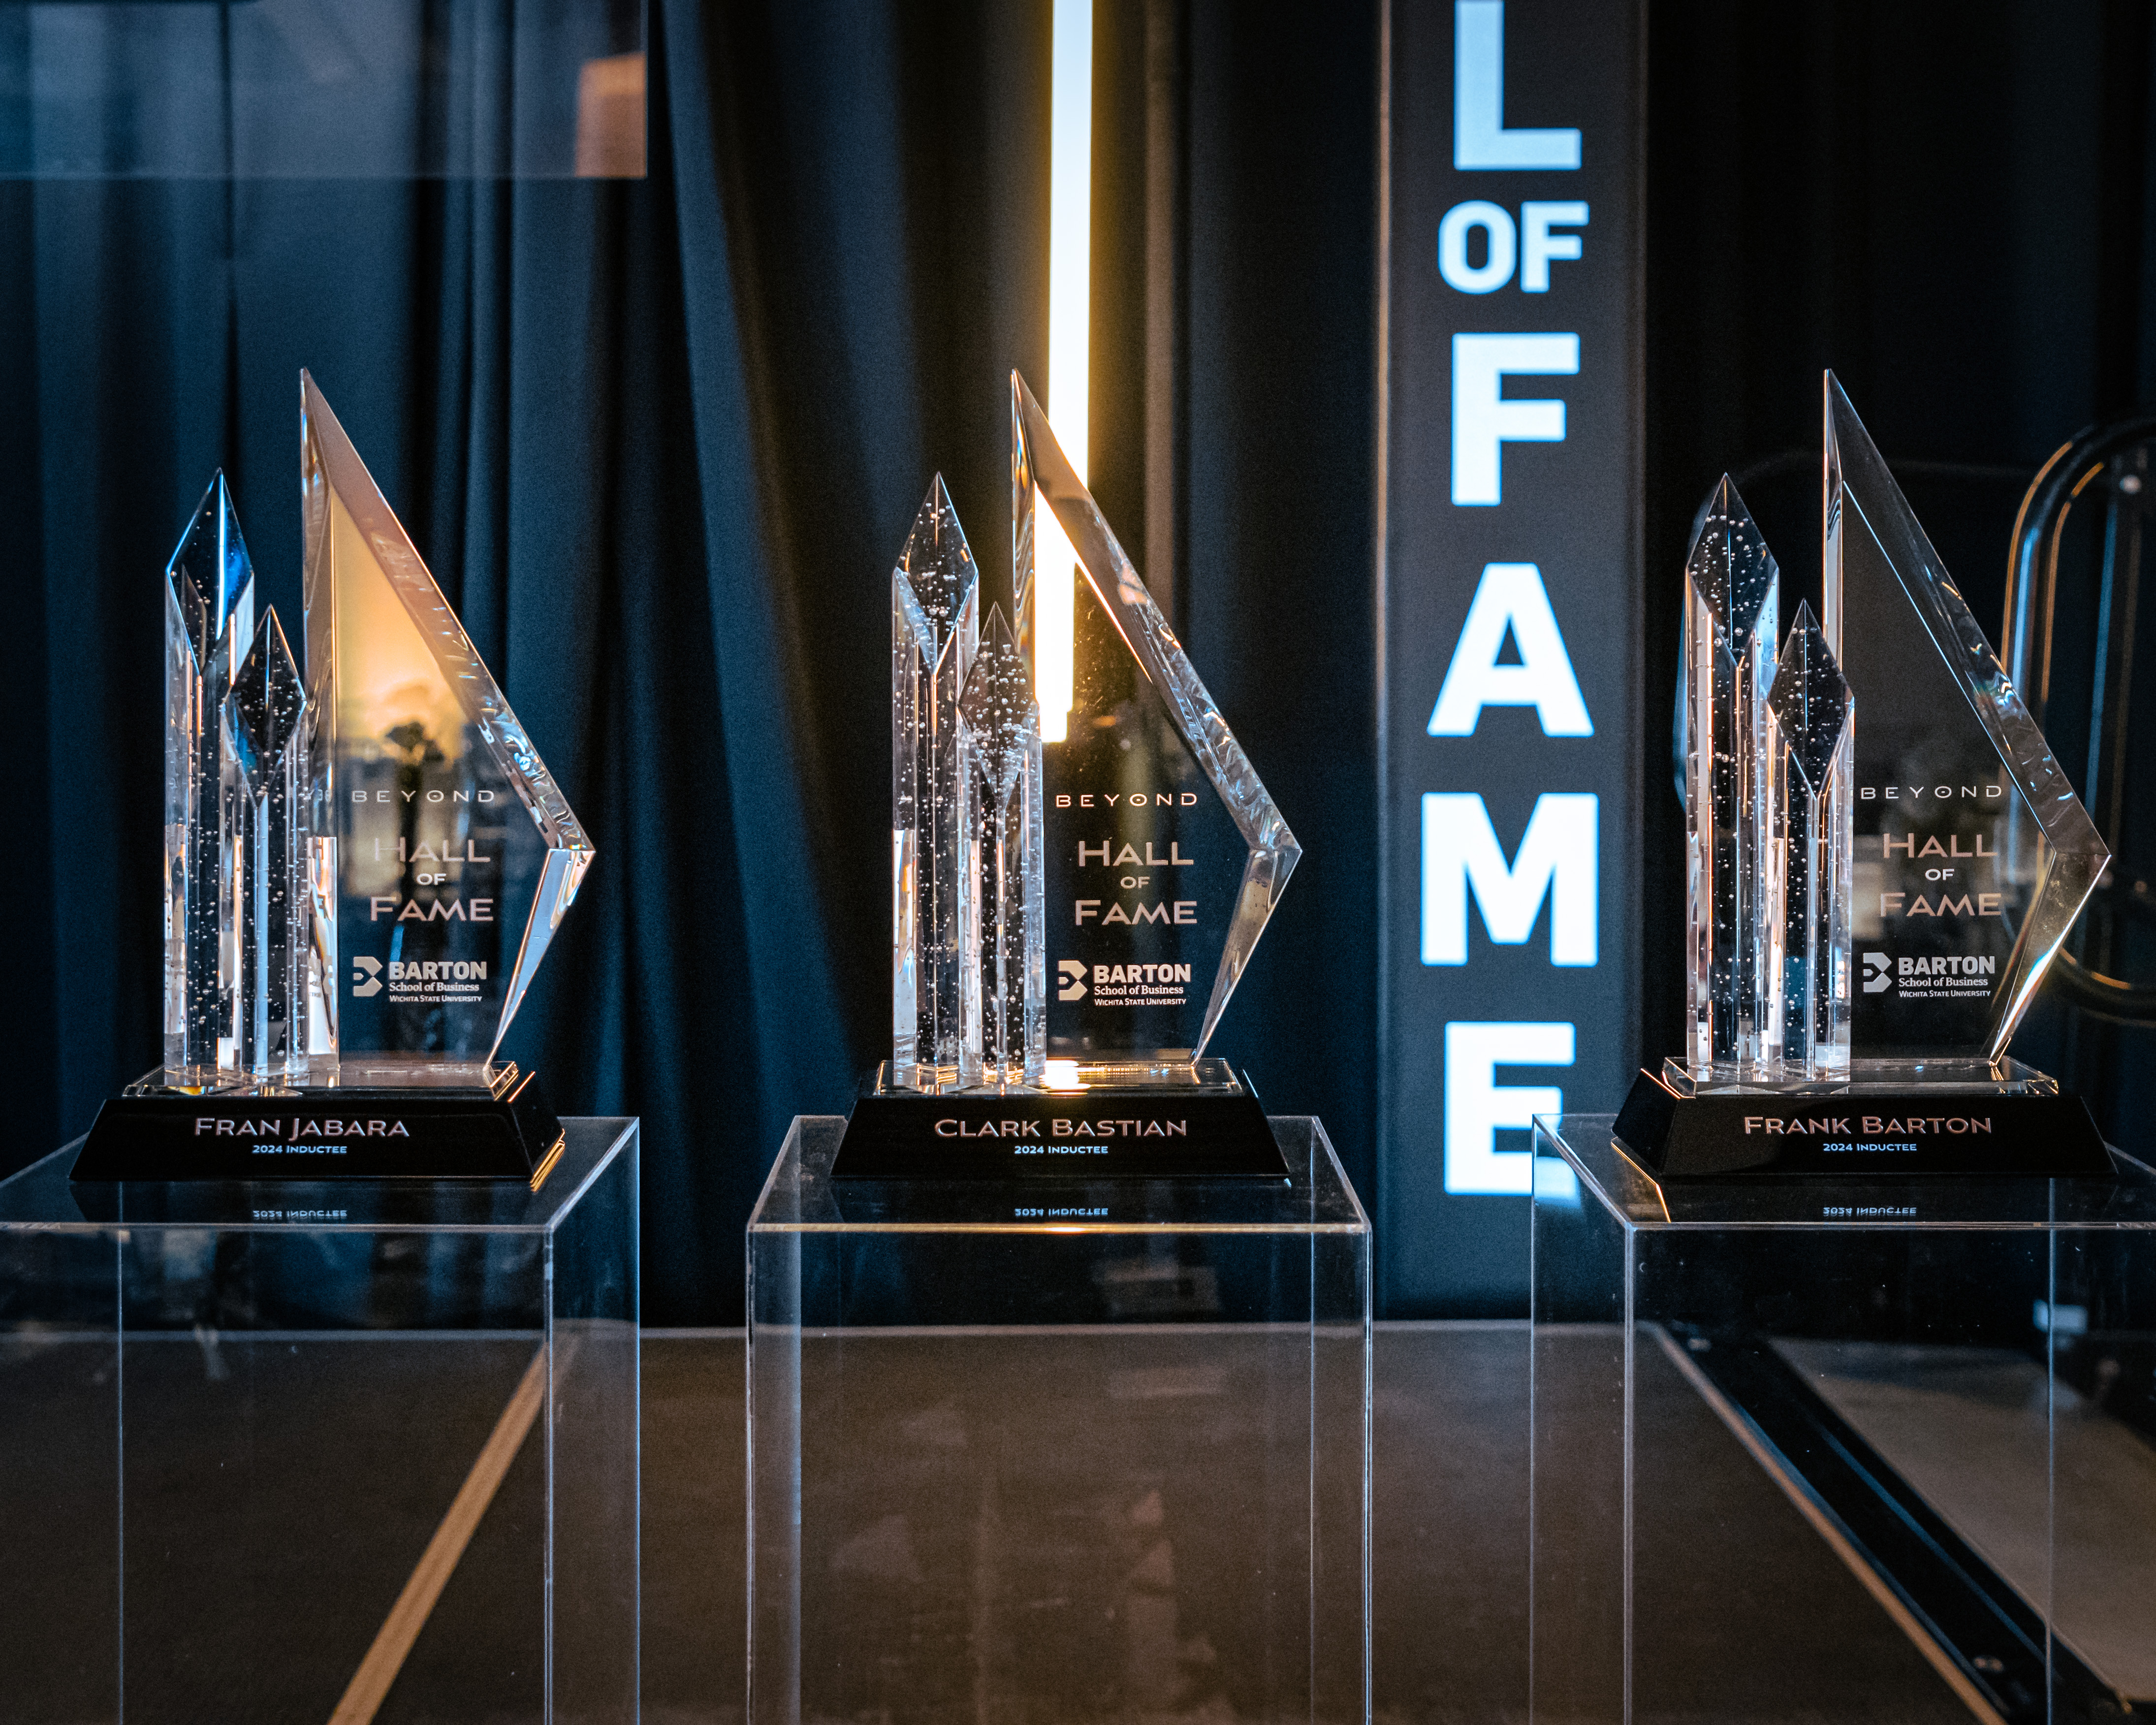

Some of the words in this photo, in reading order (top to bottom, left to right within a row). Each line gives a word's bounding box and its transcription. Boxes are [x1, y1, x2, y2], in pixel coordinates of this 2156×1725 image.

[1437, 199, 1590, 295] OF
[1421, 333, 1598, 1196] FAME
[351, 790, 494, 802] BEYOND
[1055, 793, 1197, 807] BEYOND
[1861, 786, 2001, 799] BEYOND
[375, 836, 491, 862] HALL
[1078, 840, 1194, 866] HALL
[1883, 833, 1998, 858] HALL
[417, 873, 446, 886] OF
[1120, 876, 1150, 889] OF
[1925, 868, 1955, 880] OF
[371, 896, 493, 922] FAME
[1076, 899, 1198, 926] FAME
[1880, 893, 2001, 917] FAME
[389, 961, 487, 980] BARTON
[1094, 963, 1191, 983] BARTON
[1899, 956, 1995, 975] BARTON
[389, 982, 422, 992] School
[424, 982, 435, 991] of
[437, 982, 479, 991] Business
[1094, 985, 1127, 995] School
[1129, 985, 1140, 994] of
[1141, 985, 1183, 994] Business
[1899, 978, 1931, 987] School
[1934, 977, 1944, 986] of
[1945, 977, 1988, 986] Business
[195, 1118, 280, 1136] FRAN
[288, 1118, 410, 1142] JABARA
[935, 1119, 1041, 1137] CLARK
[1052, 1118, 1187, 1137] BASTIAN
[1744, 1117, 1851, 1134] FRANK
[1862, 1116, 1992, 1134] BARTON
[252, 1145, 283, 1154] 2024
[286, 1145, 347, 1154] INDUCTEE
[1014, 1146, 1044, 1154] 2024
[1048, 1146, 1108, 1154] INDUCTEE
[1823, 1143, 1853, 1151] 2024
[1857, 1143, 1917, 1151] INDUCTEE
